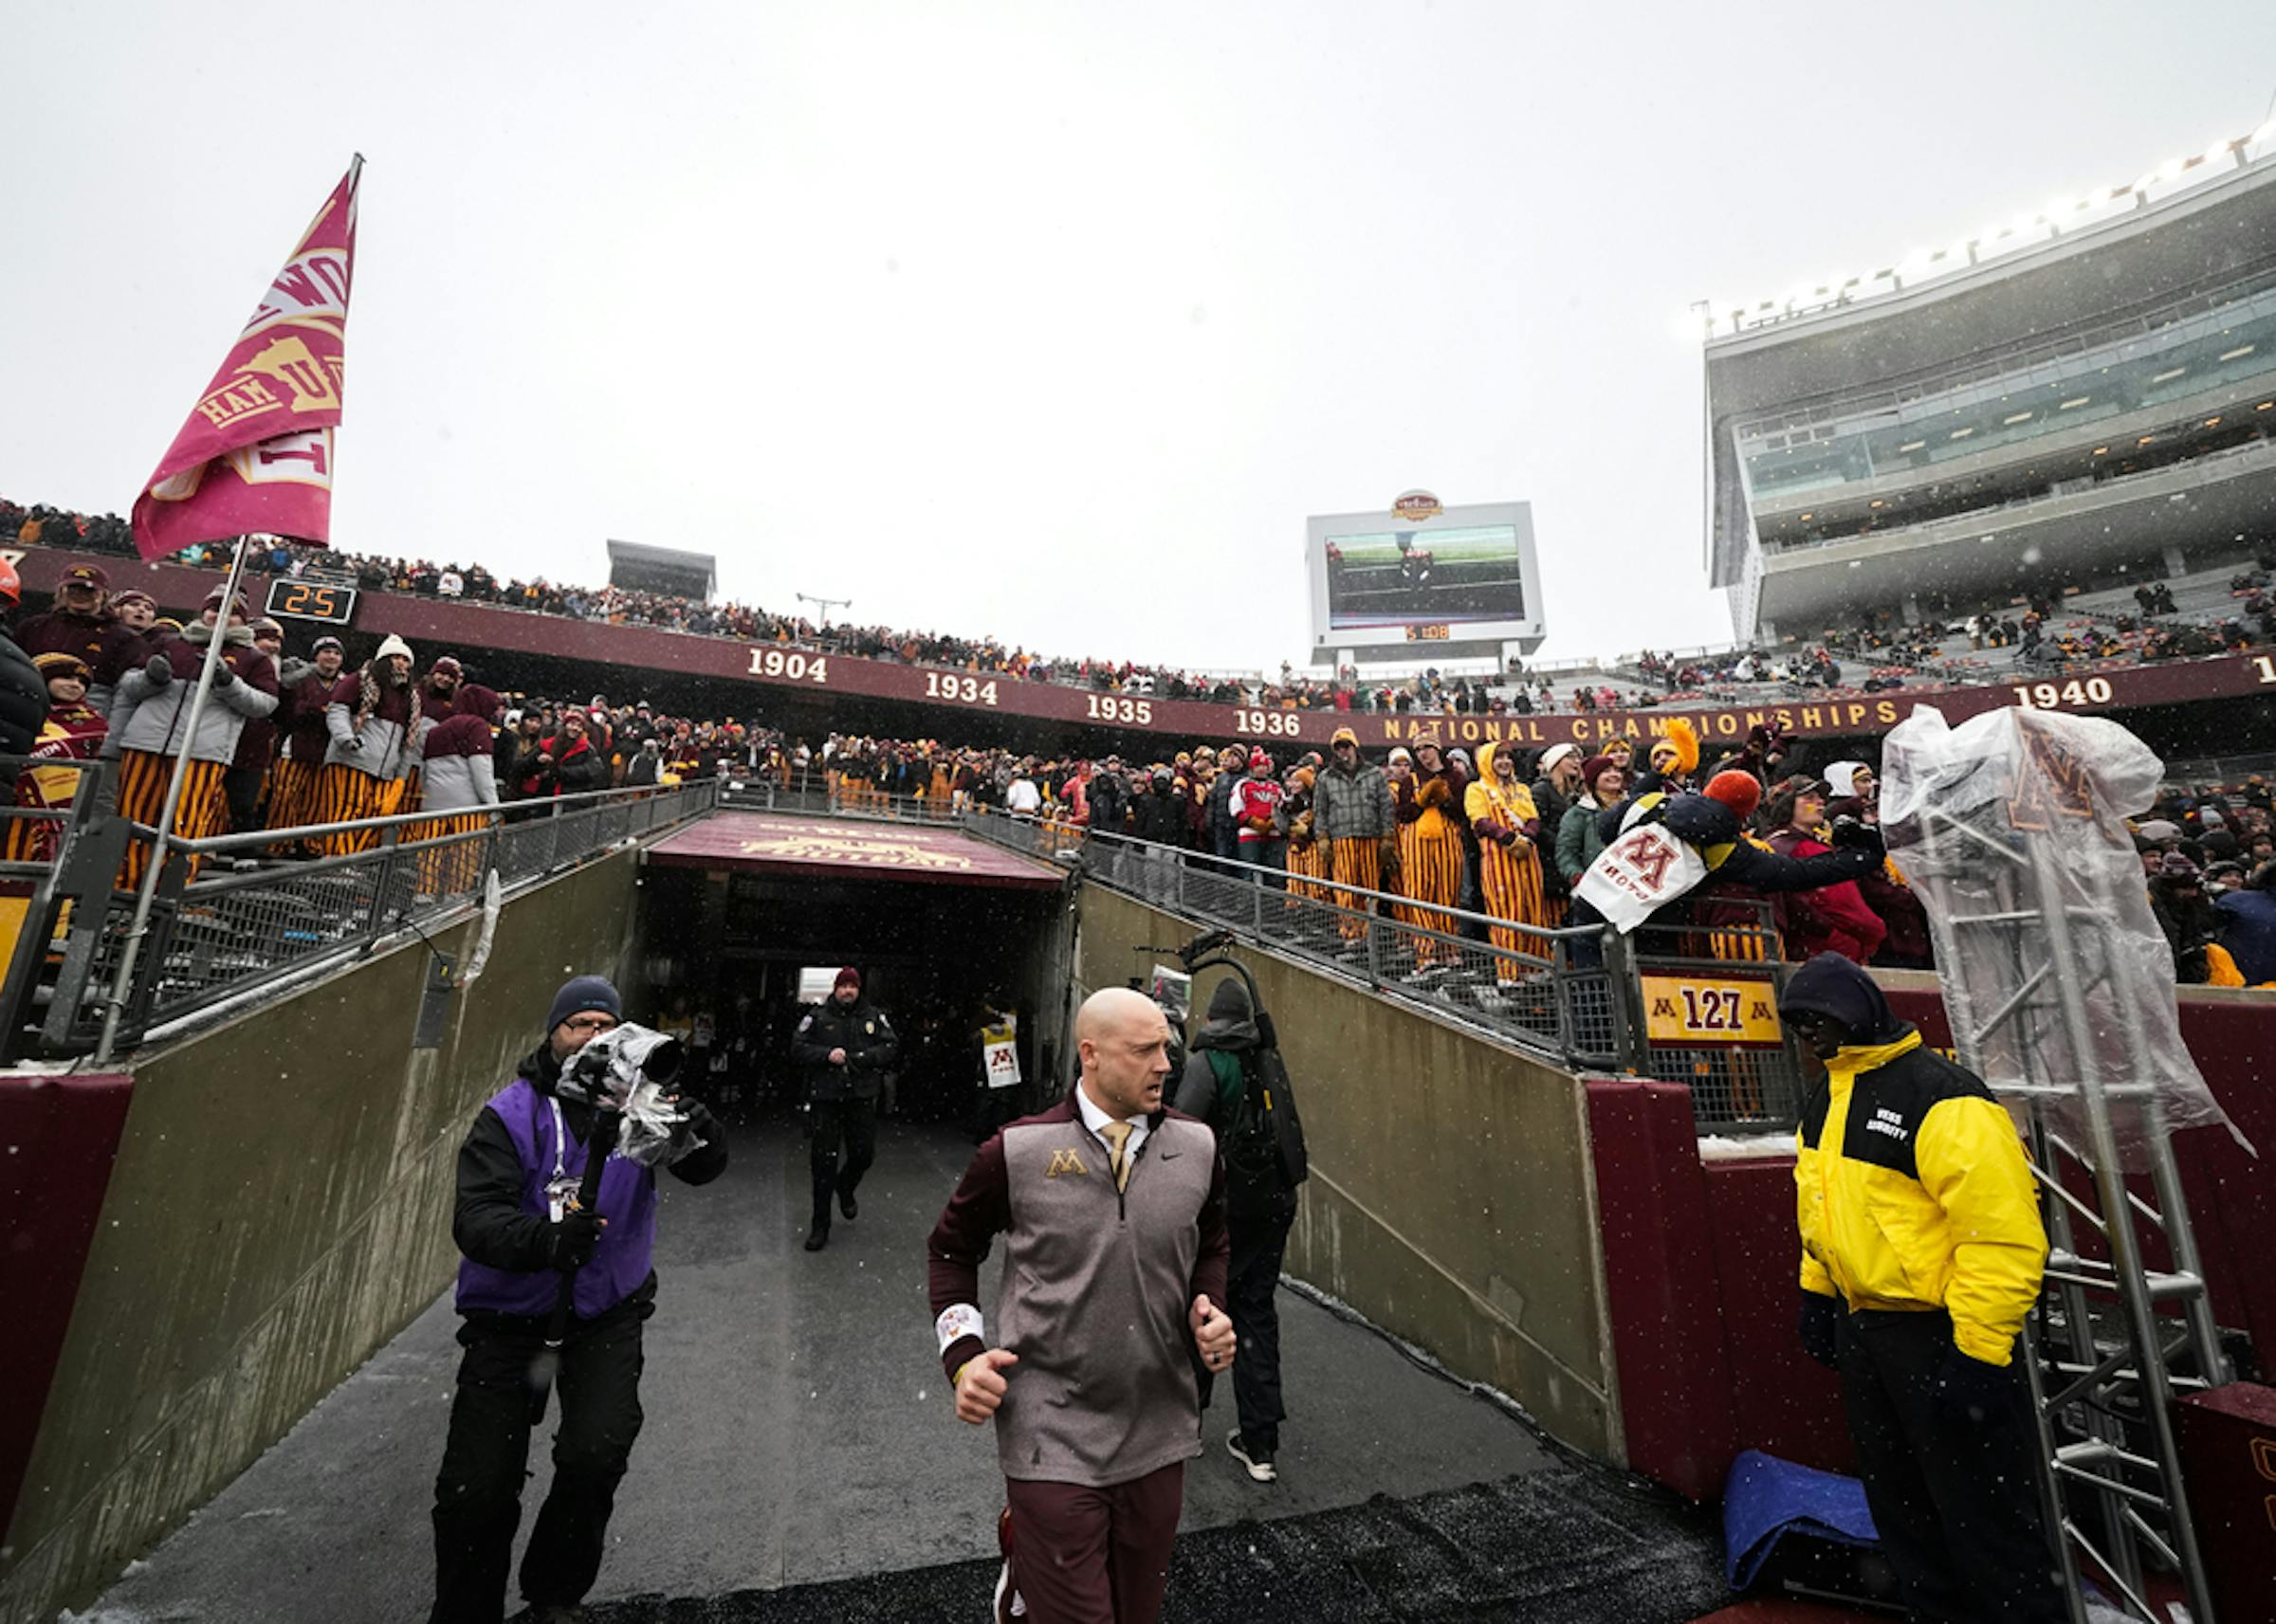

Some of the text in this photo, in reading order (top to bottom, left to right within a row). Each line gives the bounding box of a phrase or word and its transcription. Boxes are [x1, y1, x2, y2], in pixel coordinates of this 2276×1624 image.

[285, 584, 335, 616] 25
[747, 648, 828, 684] 1904
[926, 671, 998, 705] 1934
[1087, 694, 1152, 725] 1935
[1235, 709, 1301, 737] 1936
[1383, 719, 1546, 741] NATIONAL
[2011, 677, 2114, 711] 1940
[1680, 988, 1744, 1031] 127
[1045, 1148, 1090, 1177] M
